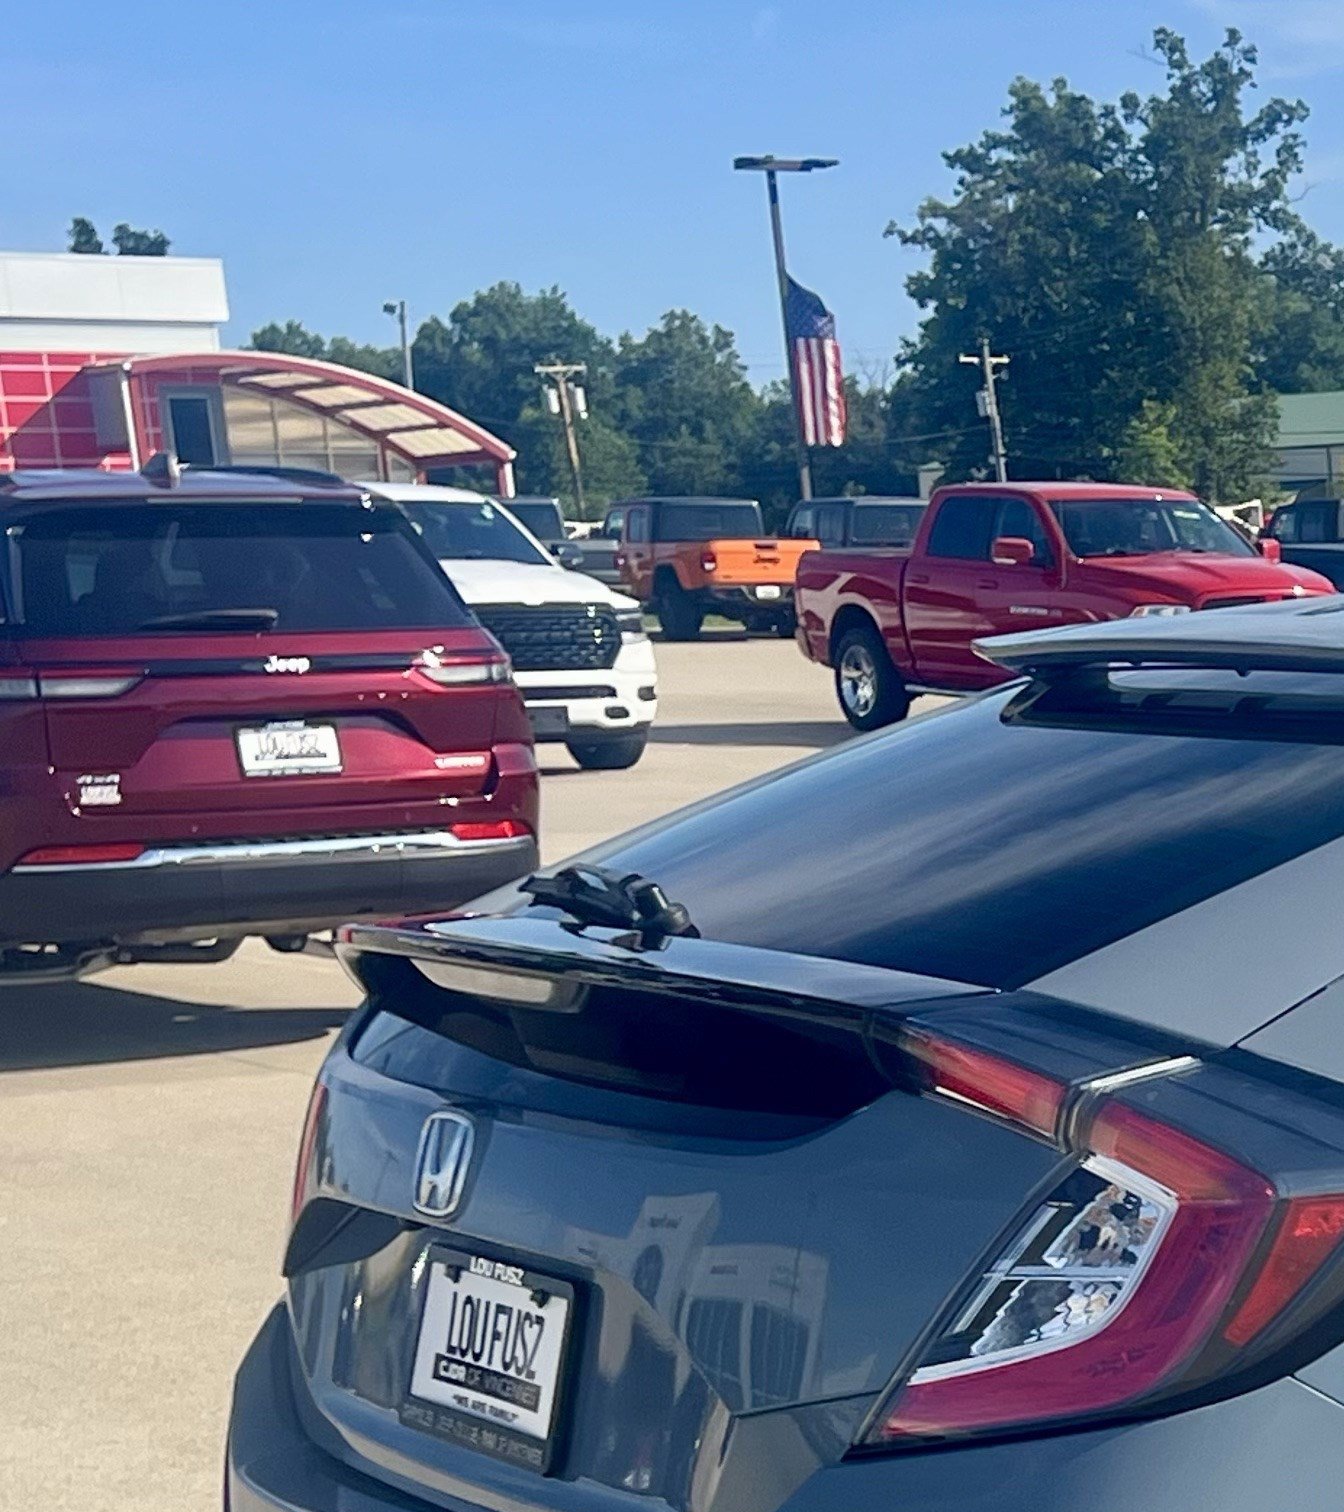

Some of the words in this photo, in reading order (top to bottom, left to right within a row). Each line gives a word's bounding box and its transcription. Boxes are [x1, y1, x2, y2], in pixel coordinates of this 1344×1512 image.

[264, 655, 310, 673] Jeep
[470, 1256, 494, 1277] LOU
[494, 1263, 525, 1286] FUSZ
[447, 1291, 490, 1362] LOU
[487, 1303, 545, 1380] FUSZ
